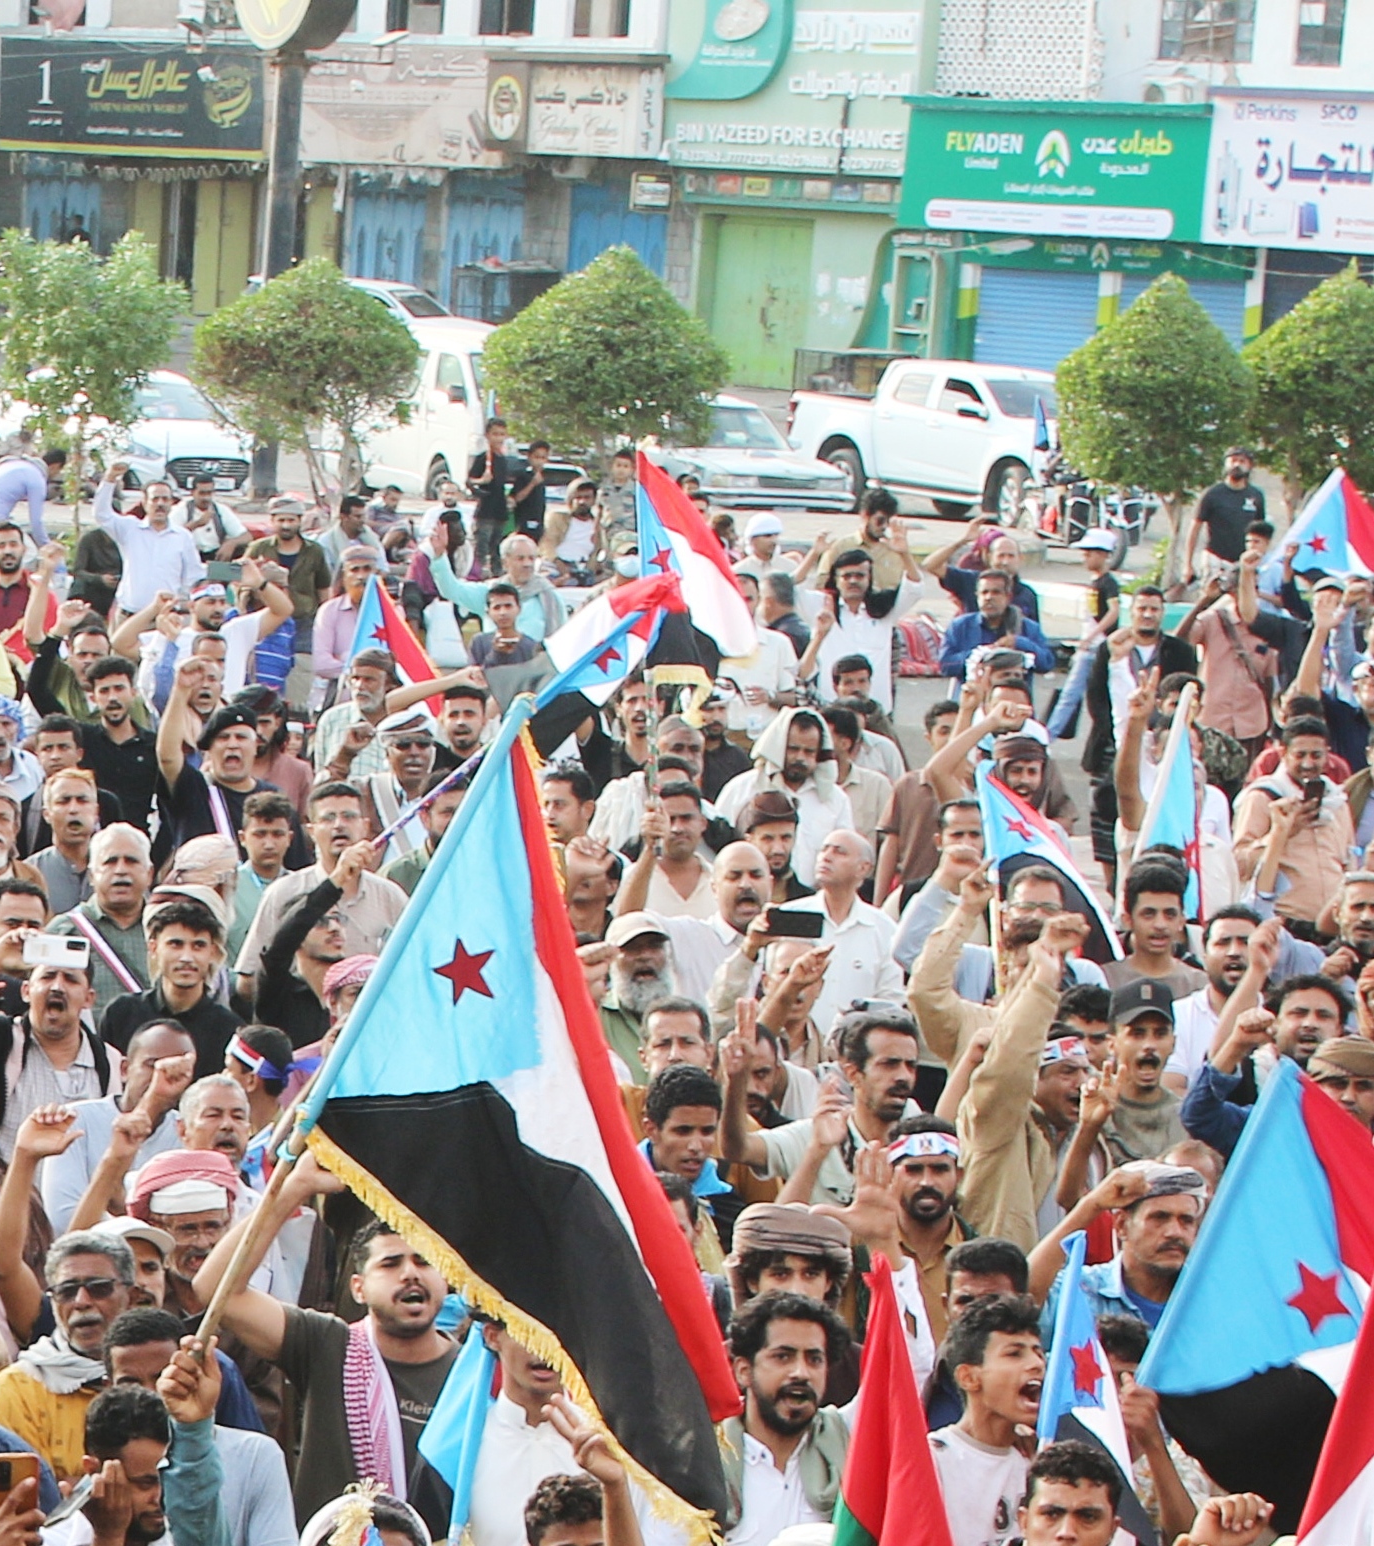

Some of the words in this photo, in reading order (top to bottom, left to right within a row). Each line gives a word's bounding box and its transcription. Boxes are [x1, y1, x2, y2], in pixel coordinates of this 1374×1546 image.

[38, 60, 53, 104] 1
[1247, 104, 1298, 121] Perkins
[1320, 104, 1358, 121] SPCO
[675, 123, 704, 143] BIN
[706, 123, 769, 145] YAZEED
[770, 126, 805, 147] FOR
[809, 127, 904, 150] EXCHANGE
[945, 130, 1024, 154] FLYADEN
[1080, 136, 1118, 155] عدن
[1118, 129, 1174, 158] طيران
